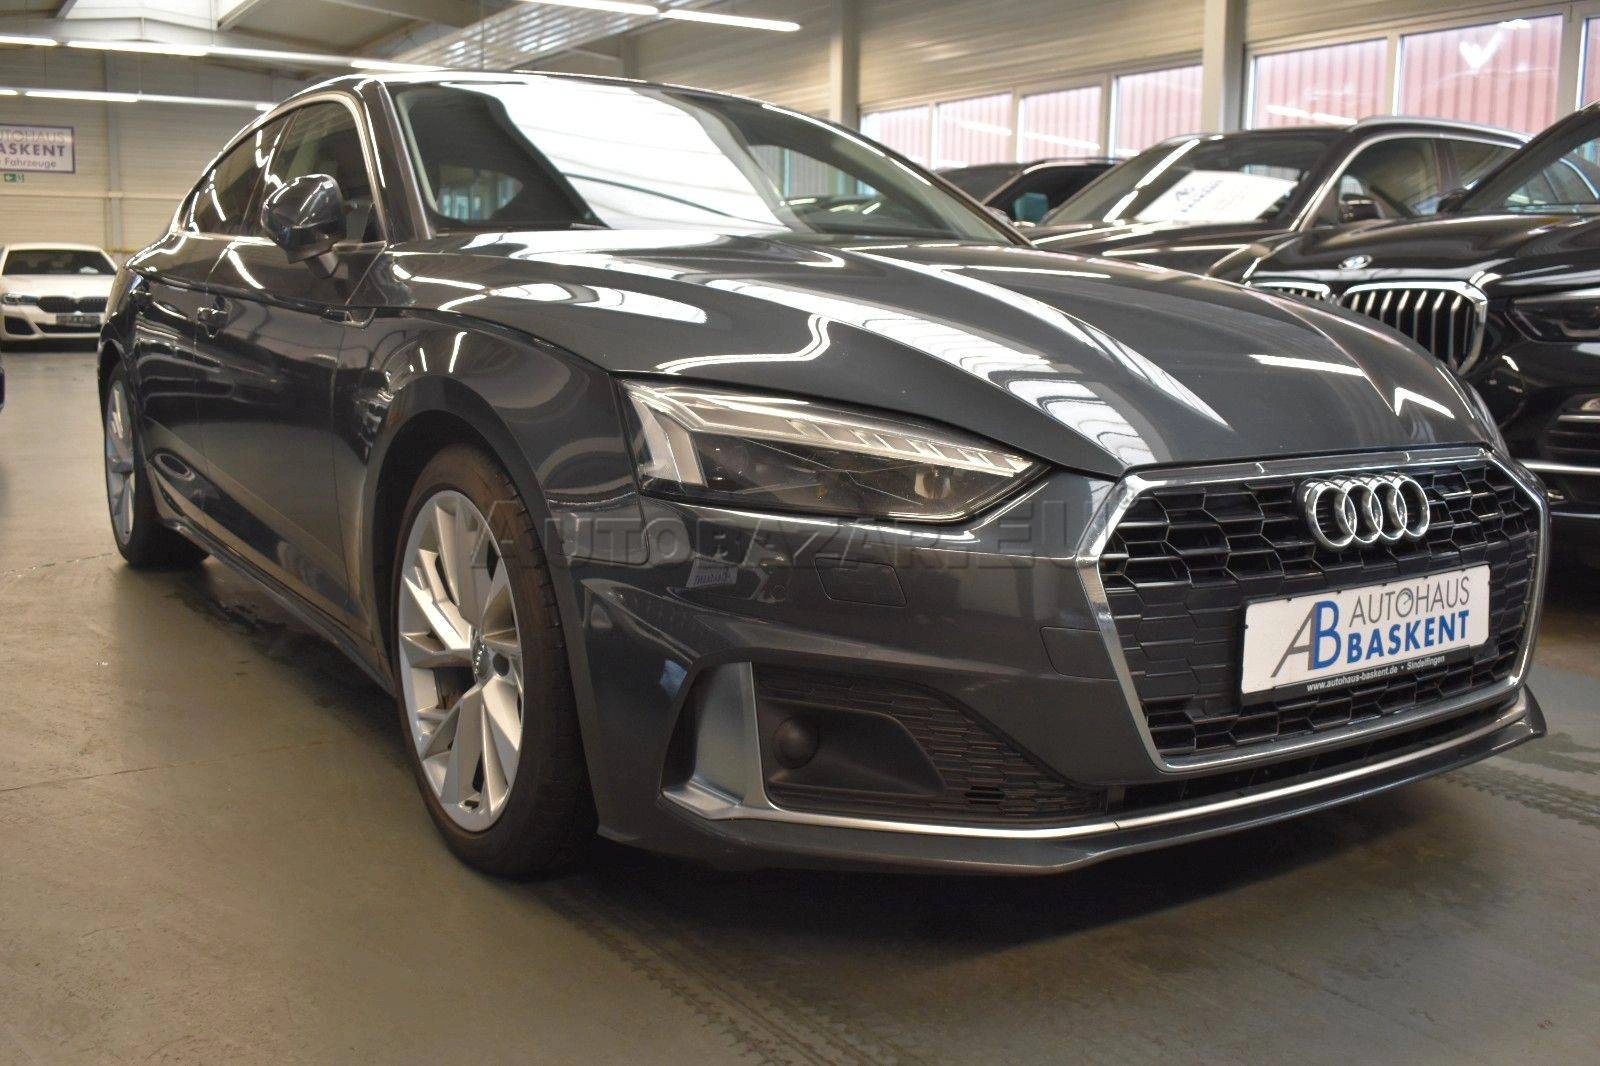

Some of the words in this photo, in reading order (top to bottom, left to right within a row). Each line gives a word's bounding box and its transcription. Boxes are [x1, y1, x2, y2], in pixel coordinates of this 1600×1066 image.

[5, 157, 57, 169] Fahrzeuge
[1349, 576, 1470, 627] AUTOHAUS
[1270, 600, 1342, 677] AB
[1346, 609, 1470, 664] BASKENT
[1306, 665, 1398, 692] www.autohaus-baskent.de
[1406, 655, 1446, 671] Sindelfingen
